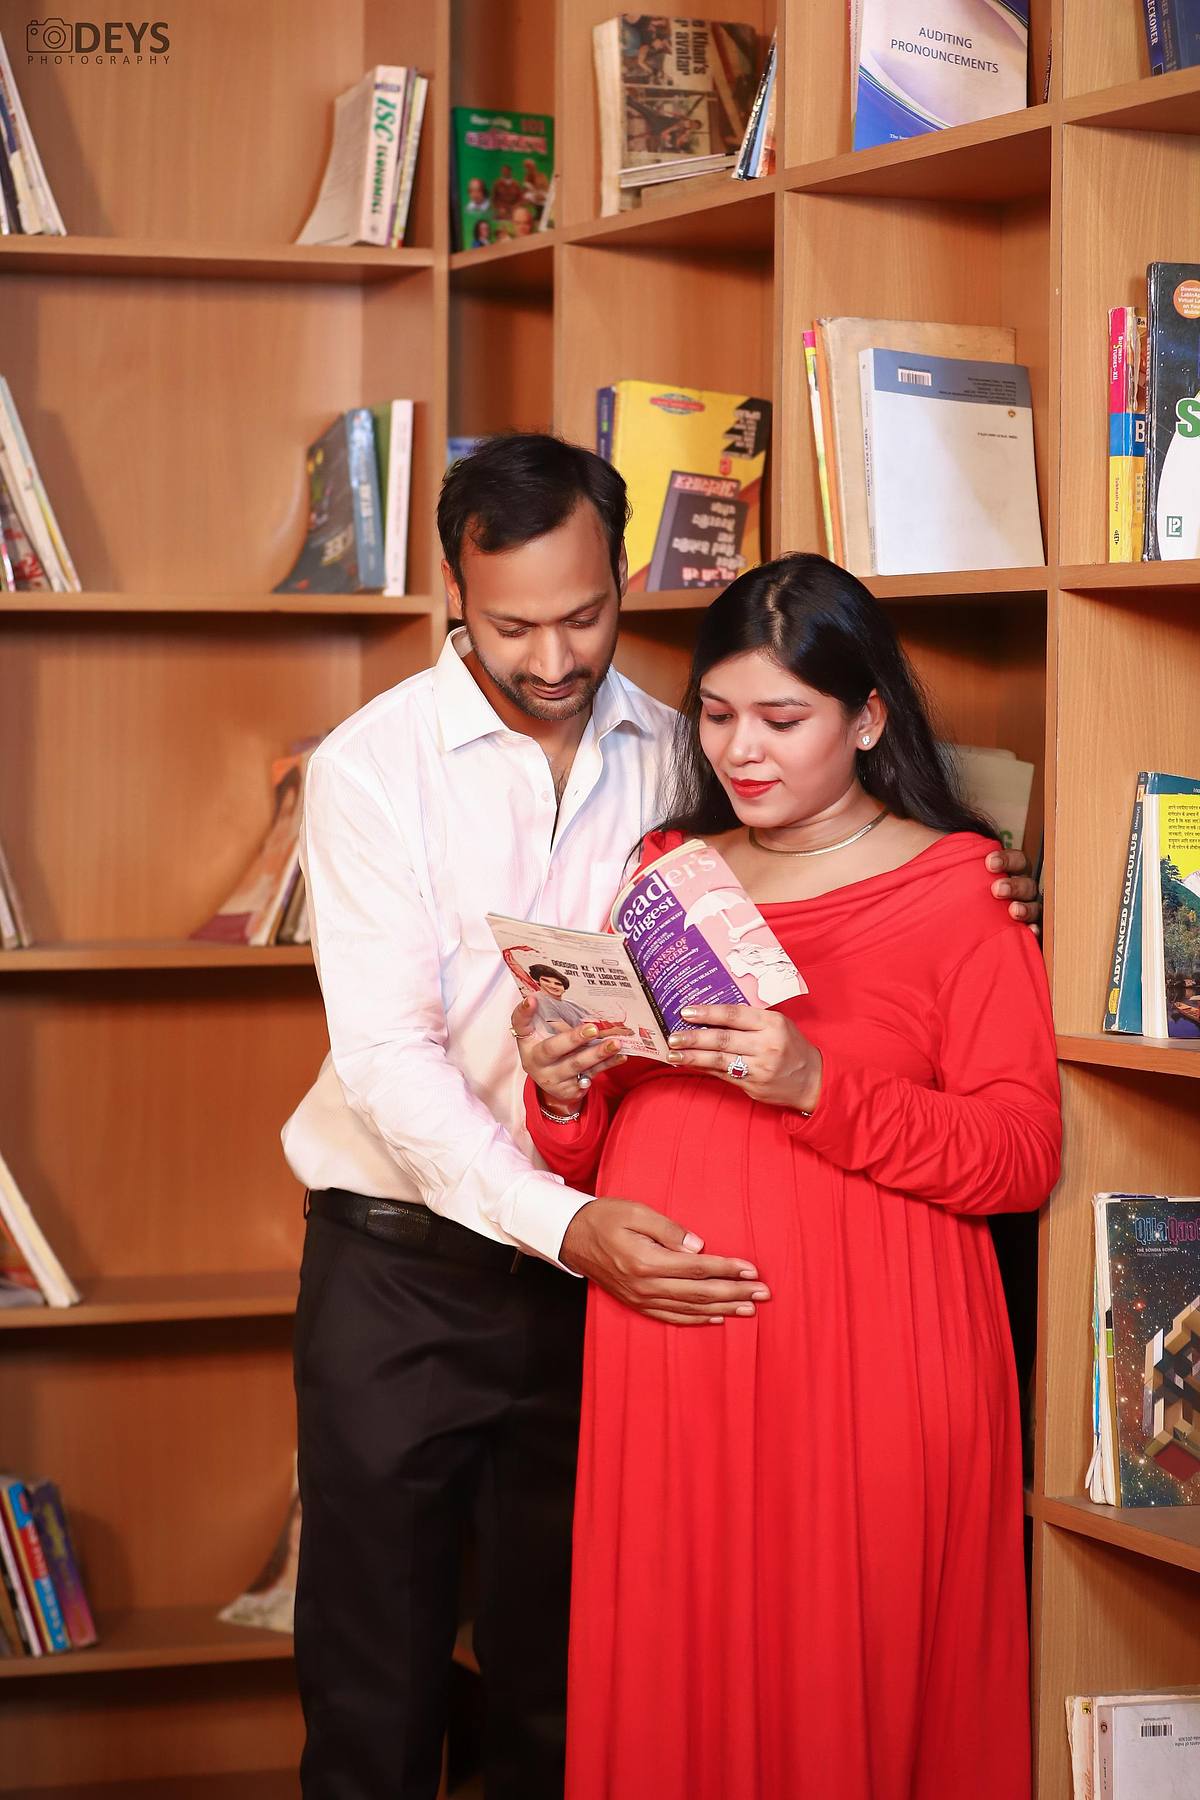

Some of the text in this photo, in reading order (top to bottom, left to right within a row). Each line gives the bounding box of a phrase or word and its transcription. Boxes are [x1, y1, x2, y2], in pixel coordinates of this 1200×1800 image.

[891, 39, 999, 73] PRONOUNCEMENTS
[918, 27, 973, 49] AUDITING
[374, 97, 397, 142] ISC
[632, 896, 676, 942] digest
[1113, 907, 1128, 985] ADVANCED
[1123, 832, 1138, 905] CALCULUS
[646, 946, 679, 980] KINDNESS
[675, 937, 686, 947] OF
[648, 945, 691, 981] STRANGERS
